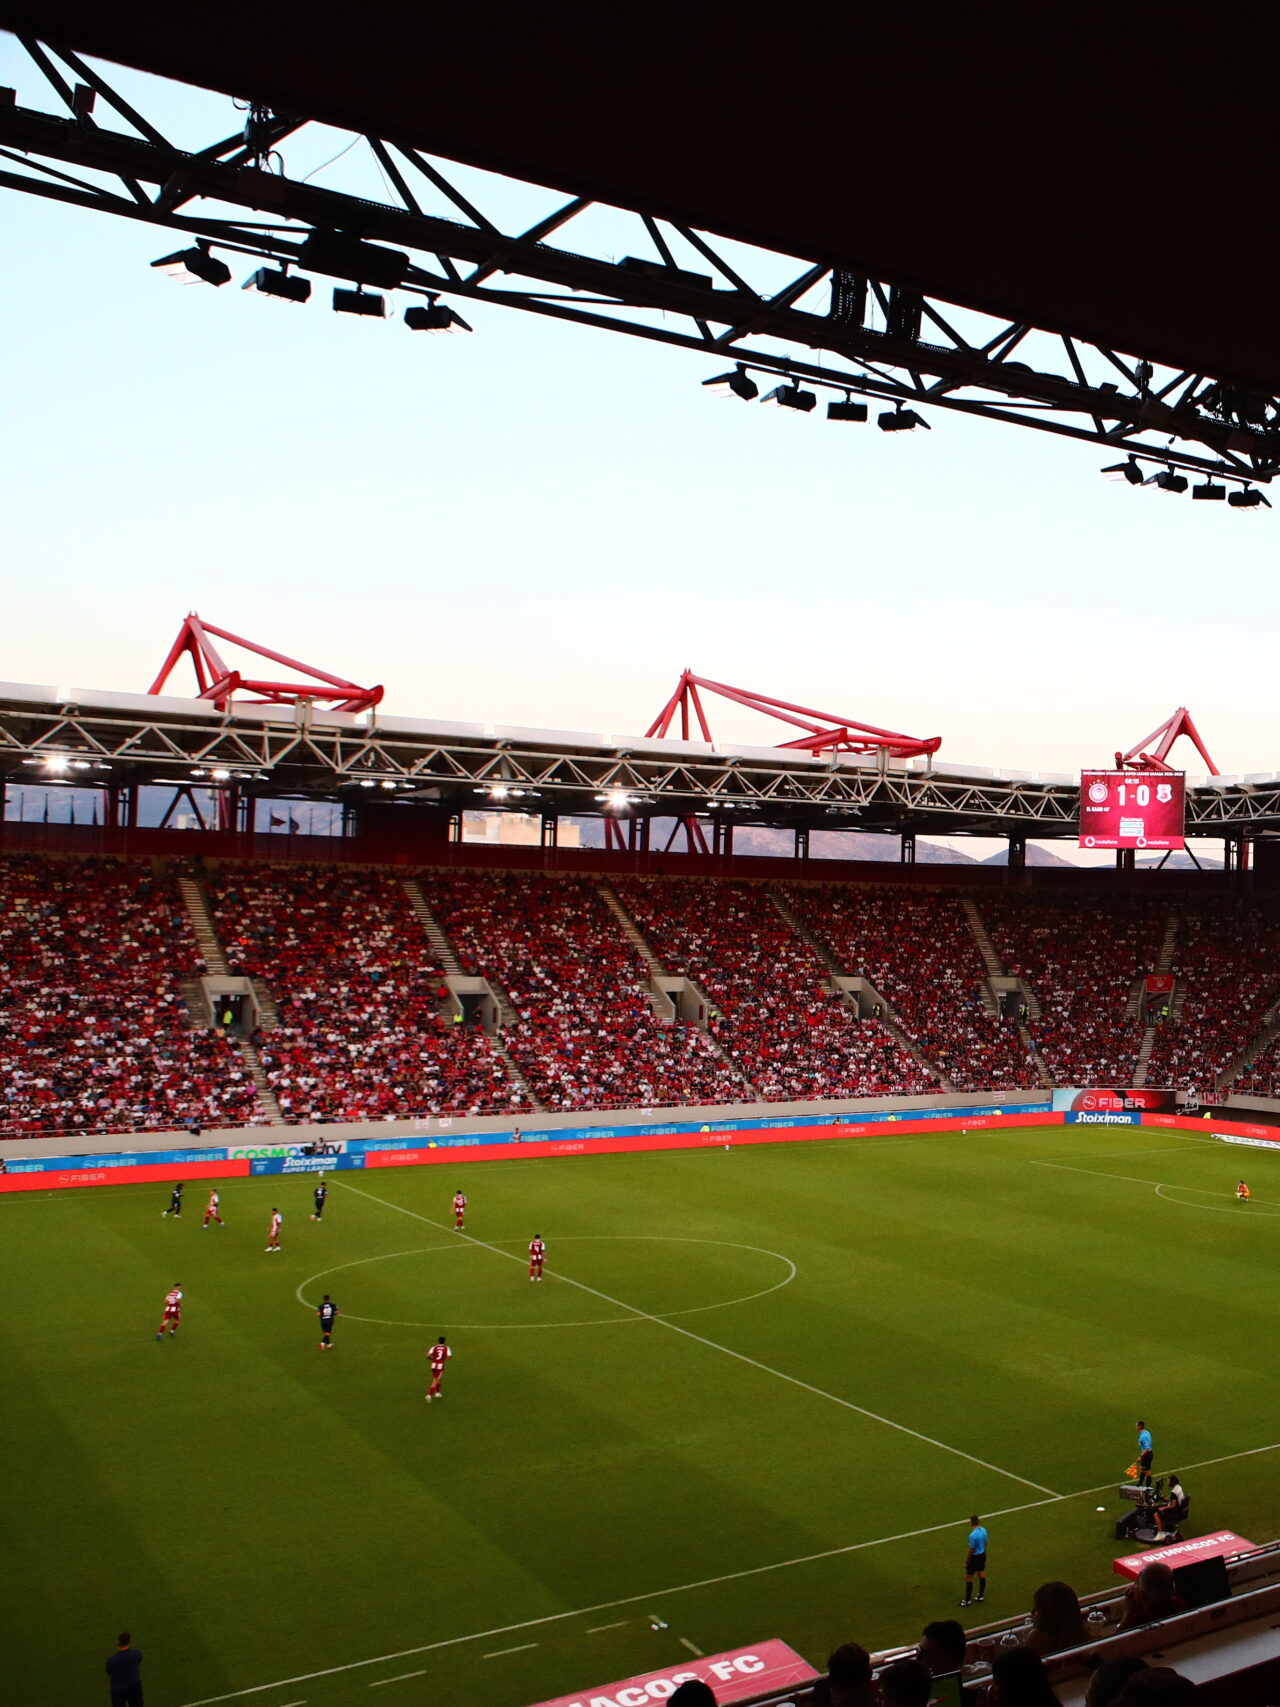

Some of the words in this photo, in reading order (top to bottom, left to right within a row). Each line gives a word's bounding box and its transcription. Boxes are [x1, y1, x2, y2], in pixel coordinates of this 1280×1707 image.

[1098, 1097, 1146, 1109] FIBER
[1075, 1111, 1132, 1124] Stoiximan
[709, 1134, 732, 1142] FIBER
[559, 1143, 584, 1151] FIBER
[187, 1153, 223, 1163] FIBER
[233, 1146, 302, 1160] COSMO
[390, 1153, 419, 1161] FIBER
[96, 1158, 138, 1168] FIBER
[282, 1156, 338, 1168] Stoiximan
[70, 1173, 106, 1182] FIBER
[435, 1350, 443, 1360] 3
[1142, 1538, 1219, 1562] OLYMPIACOS
[1217, 1534, 1236, 1543] FC
[708, 1654, 765, 1681] FC
